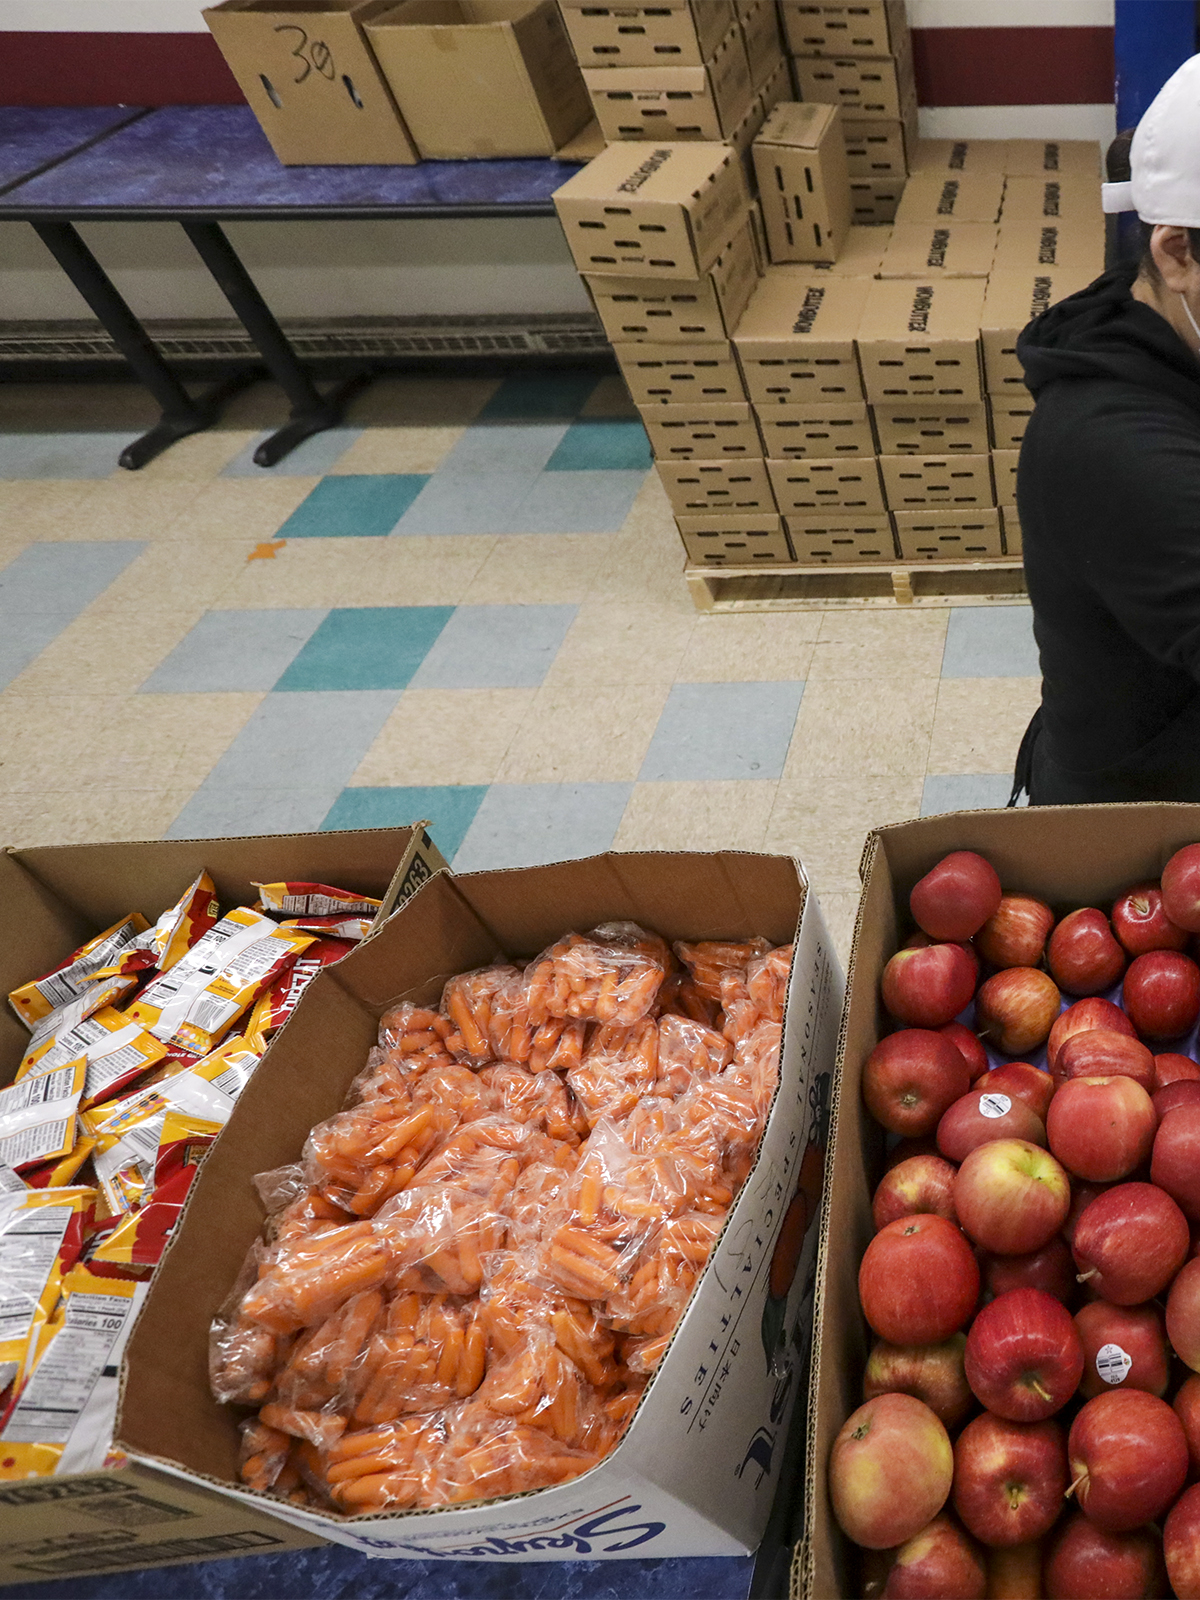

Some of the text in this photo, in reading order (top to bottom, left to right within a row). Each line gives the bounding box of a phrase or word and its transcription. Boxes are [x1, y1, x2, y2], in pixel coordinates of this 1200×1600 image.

[793, 286, 825, 334] WOWBUTTER
[908, 286, 934, 333] WOWBUTTER
[680, 1130, 797, 1417] SPECIALTIES
[101, 1318, 122, 1330] 100
